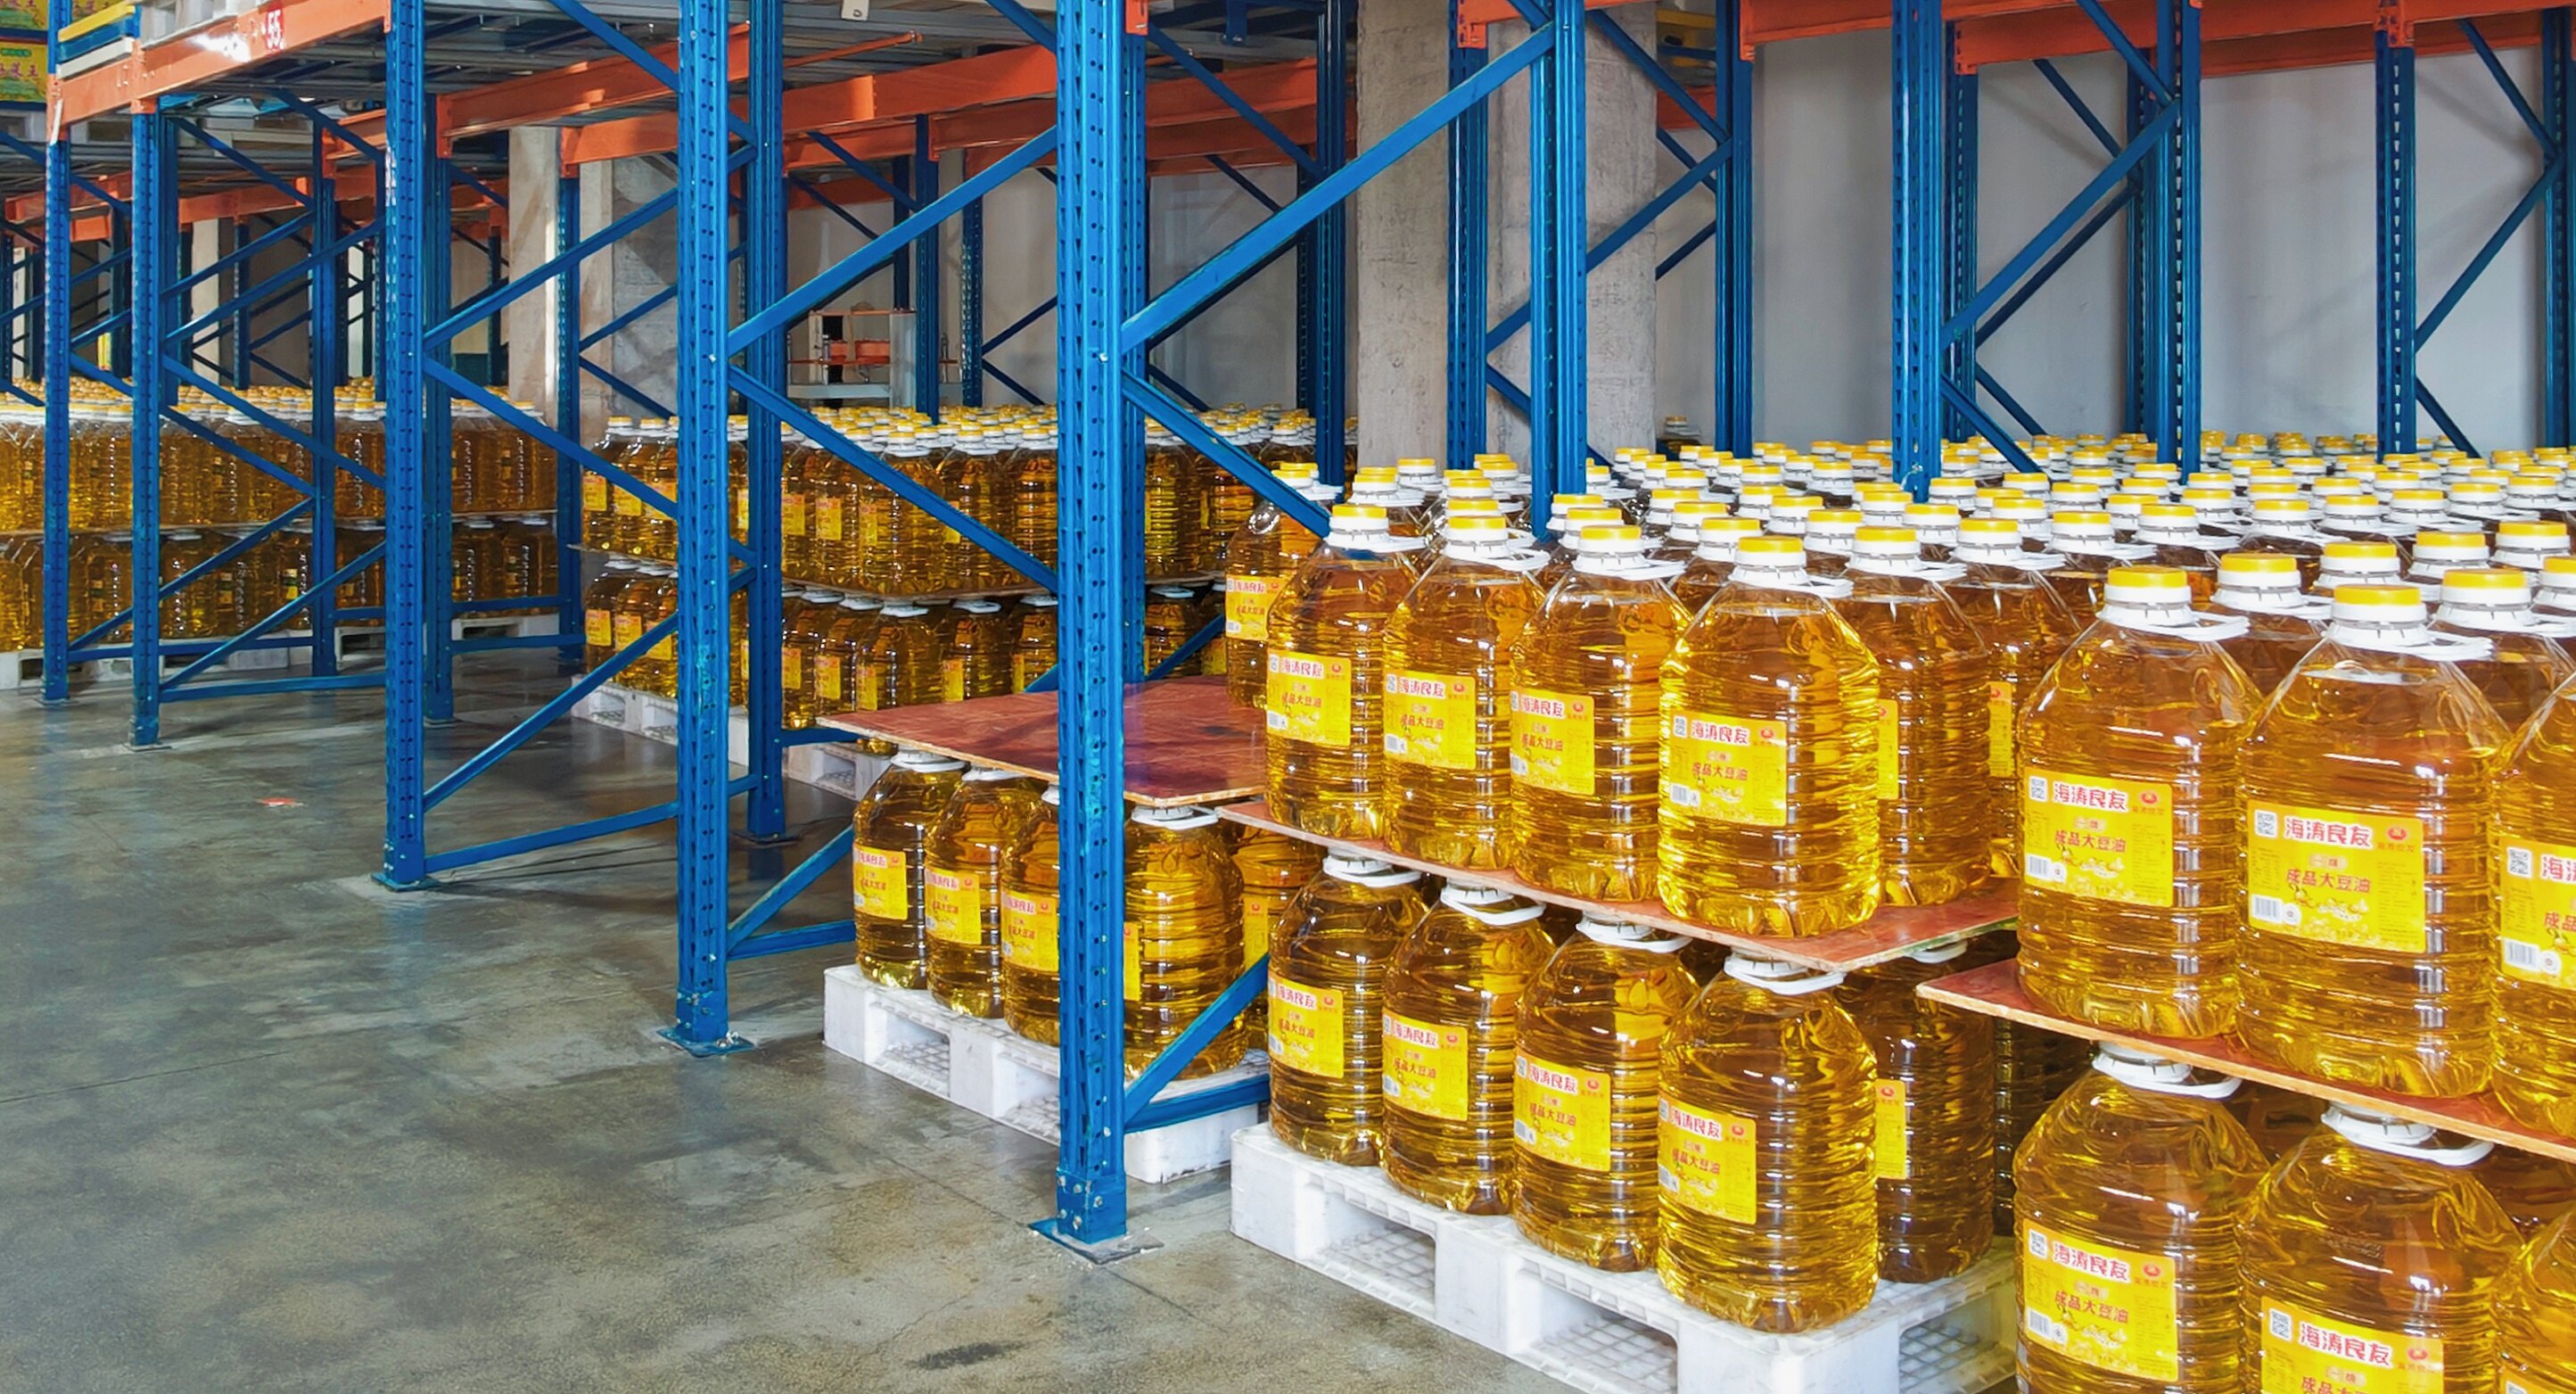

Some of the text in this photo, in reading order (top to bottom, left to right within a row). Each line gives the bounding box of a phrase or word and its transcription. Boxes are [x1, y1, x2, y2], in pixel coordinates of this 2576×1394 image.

[2054, 782, 2127, 811] 海涛良友
[2285, 817, 2372, 847] 海涛良友
[2286, 868, 2372, 894] 成品大豆油
[2300, 1323, 2391, 1366] 海涛良友
